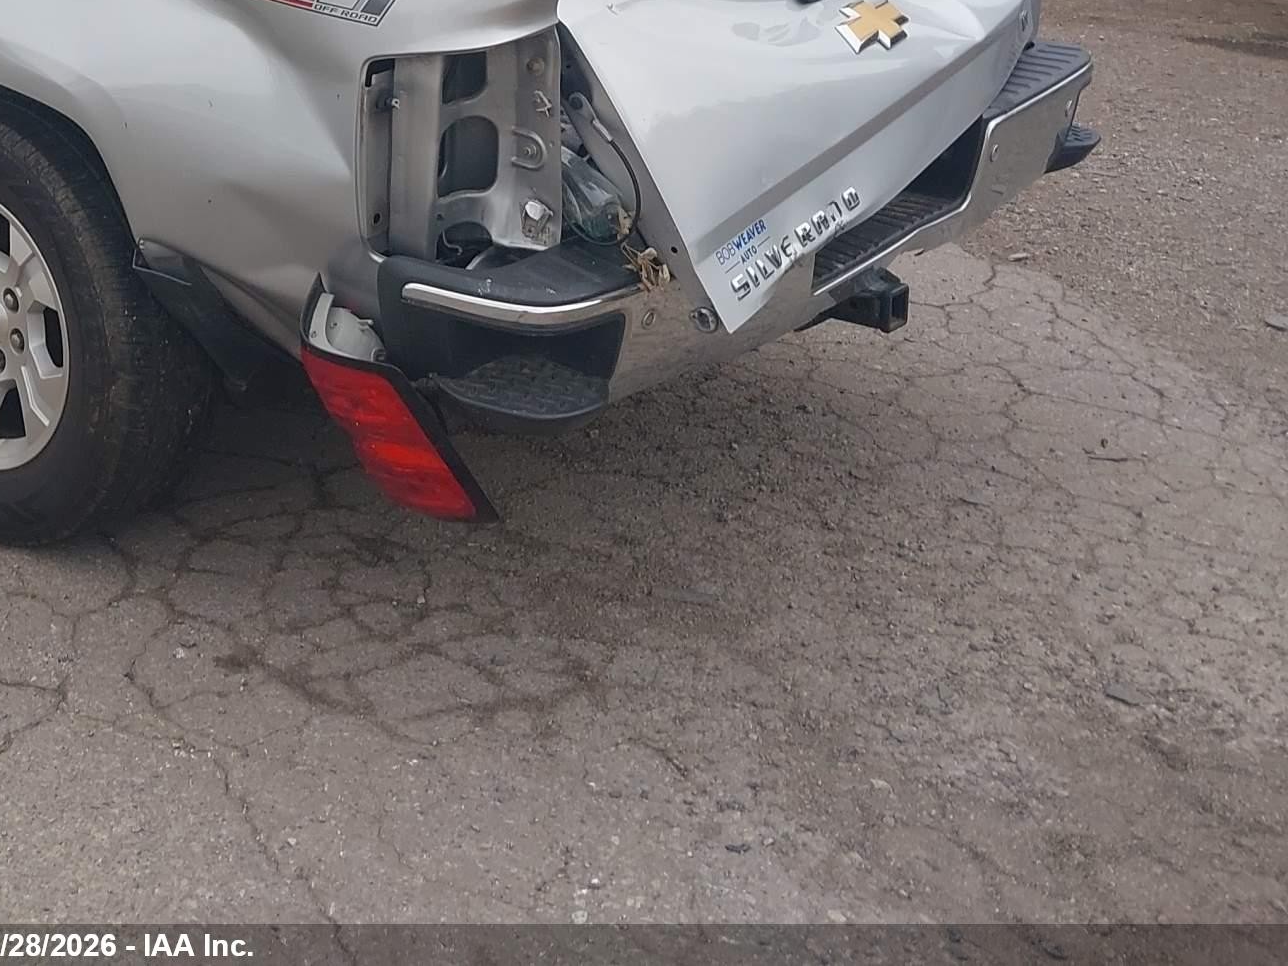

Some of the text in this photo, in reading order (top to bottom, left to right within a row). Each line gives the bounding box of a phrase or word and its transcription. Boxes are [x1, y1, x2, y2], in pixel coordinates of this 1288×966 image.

[313, 3, 378, 24] OFF ROAD
[740, 244, 758, 265] AUTO
